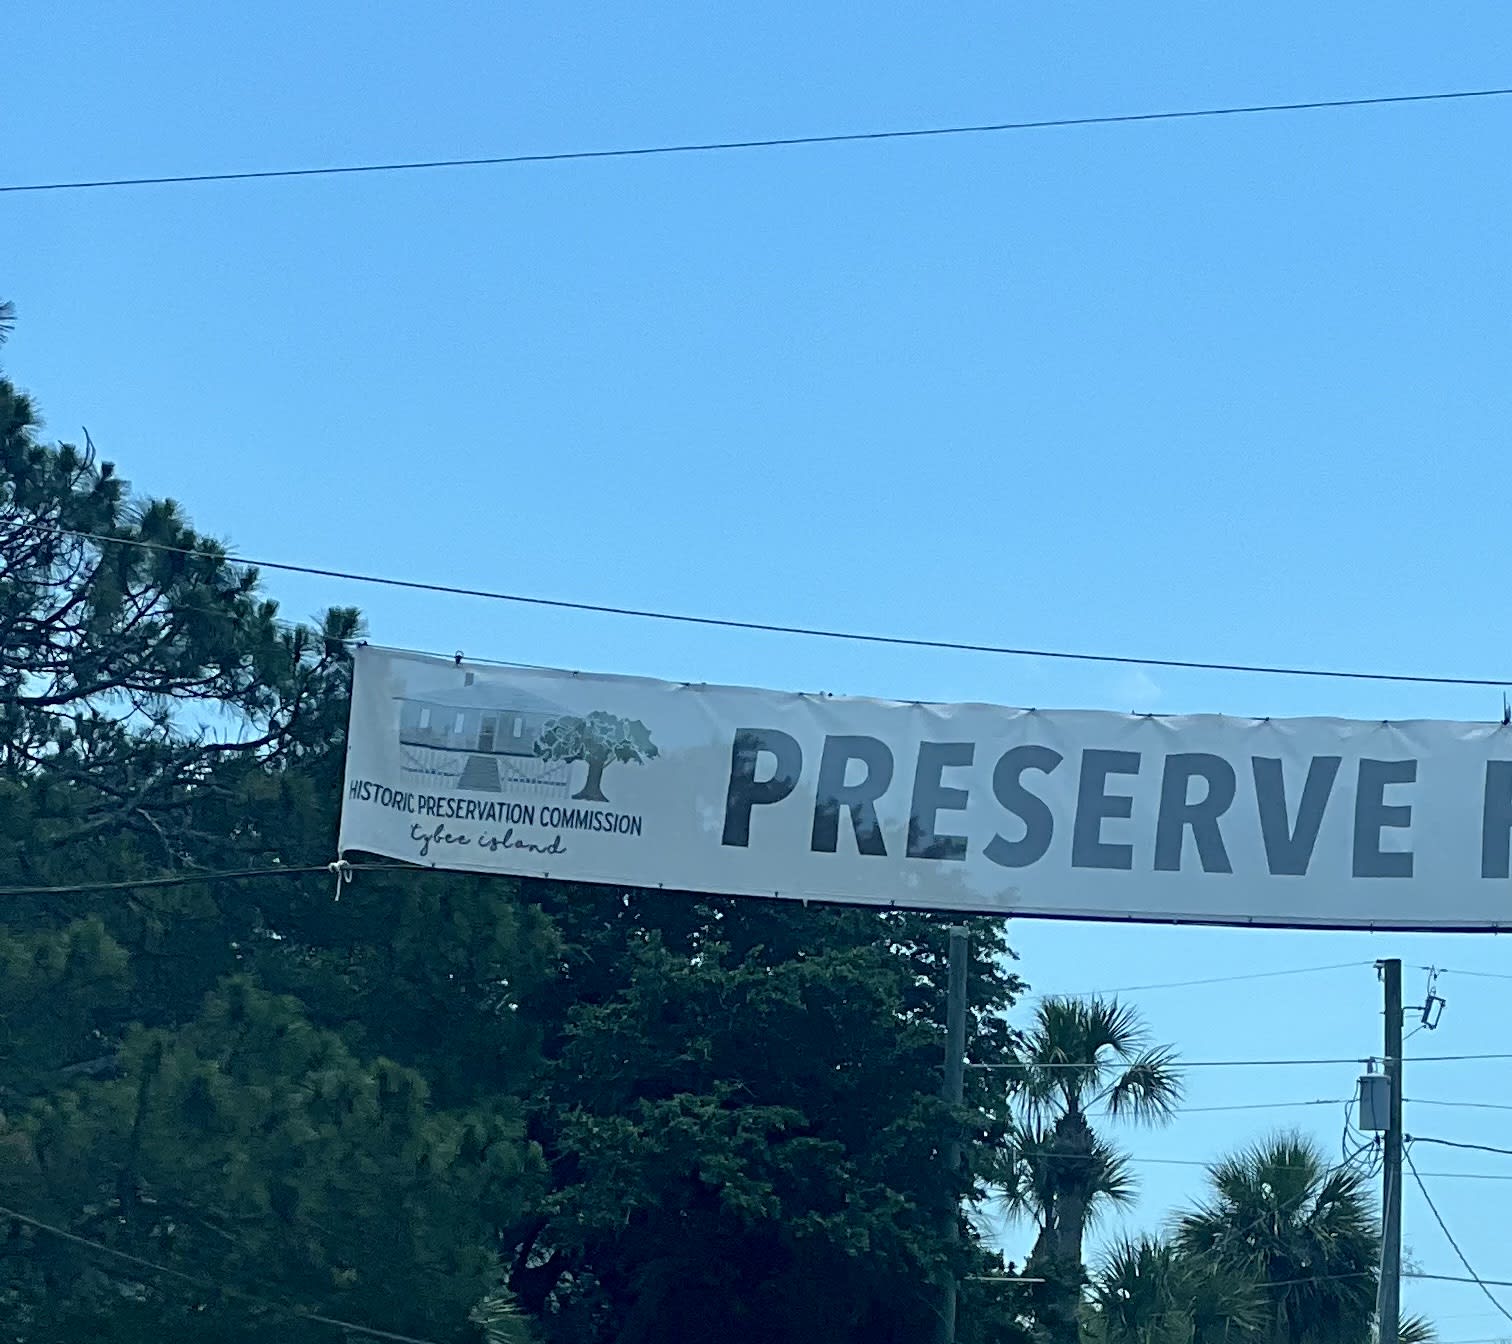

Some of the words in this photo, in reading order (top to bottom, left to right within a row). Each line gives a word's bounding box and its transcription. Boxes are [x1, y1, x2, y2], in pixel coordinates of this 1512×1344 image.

[349, 779, 415, 814] HISTORIC
[417, 794, 536, 826] PRESERVATION
[539, 806, 643, 837] COMMISSION
[722, 727, 1418, 878] PRESERVE
[478, 827, 567, 856] island
